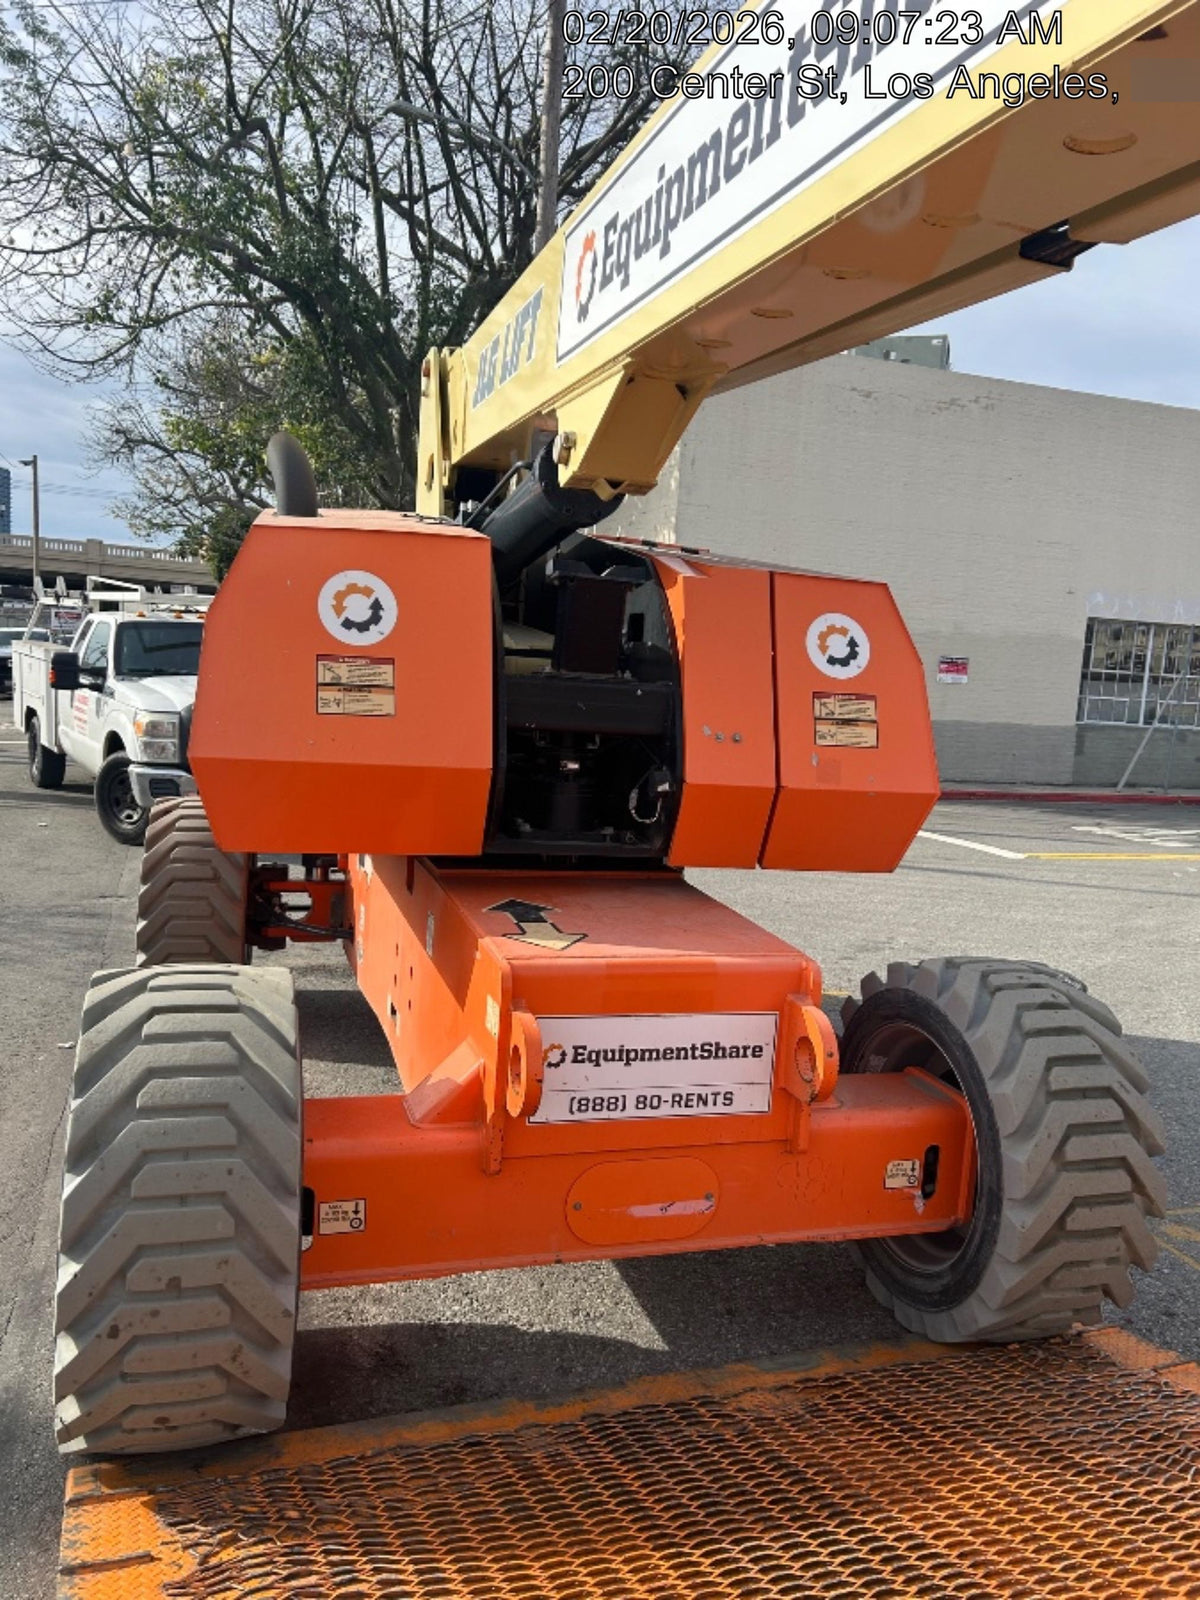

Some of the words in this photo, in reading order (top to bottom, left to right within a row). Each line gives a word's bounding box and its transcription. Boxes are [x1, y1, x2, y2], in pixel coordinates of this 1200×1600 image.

[499, 287, 543, 386] LIFT
[571, 1041, 764, 1067] EquipmentShare
[569, 1094, 627, 1114] (888)
[635, 1091, 734, 1111] 80-RENTS
